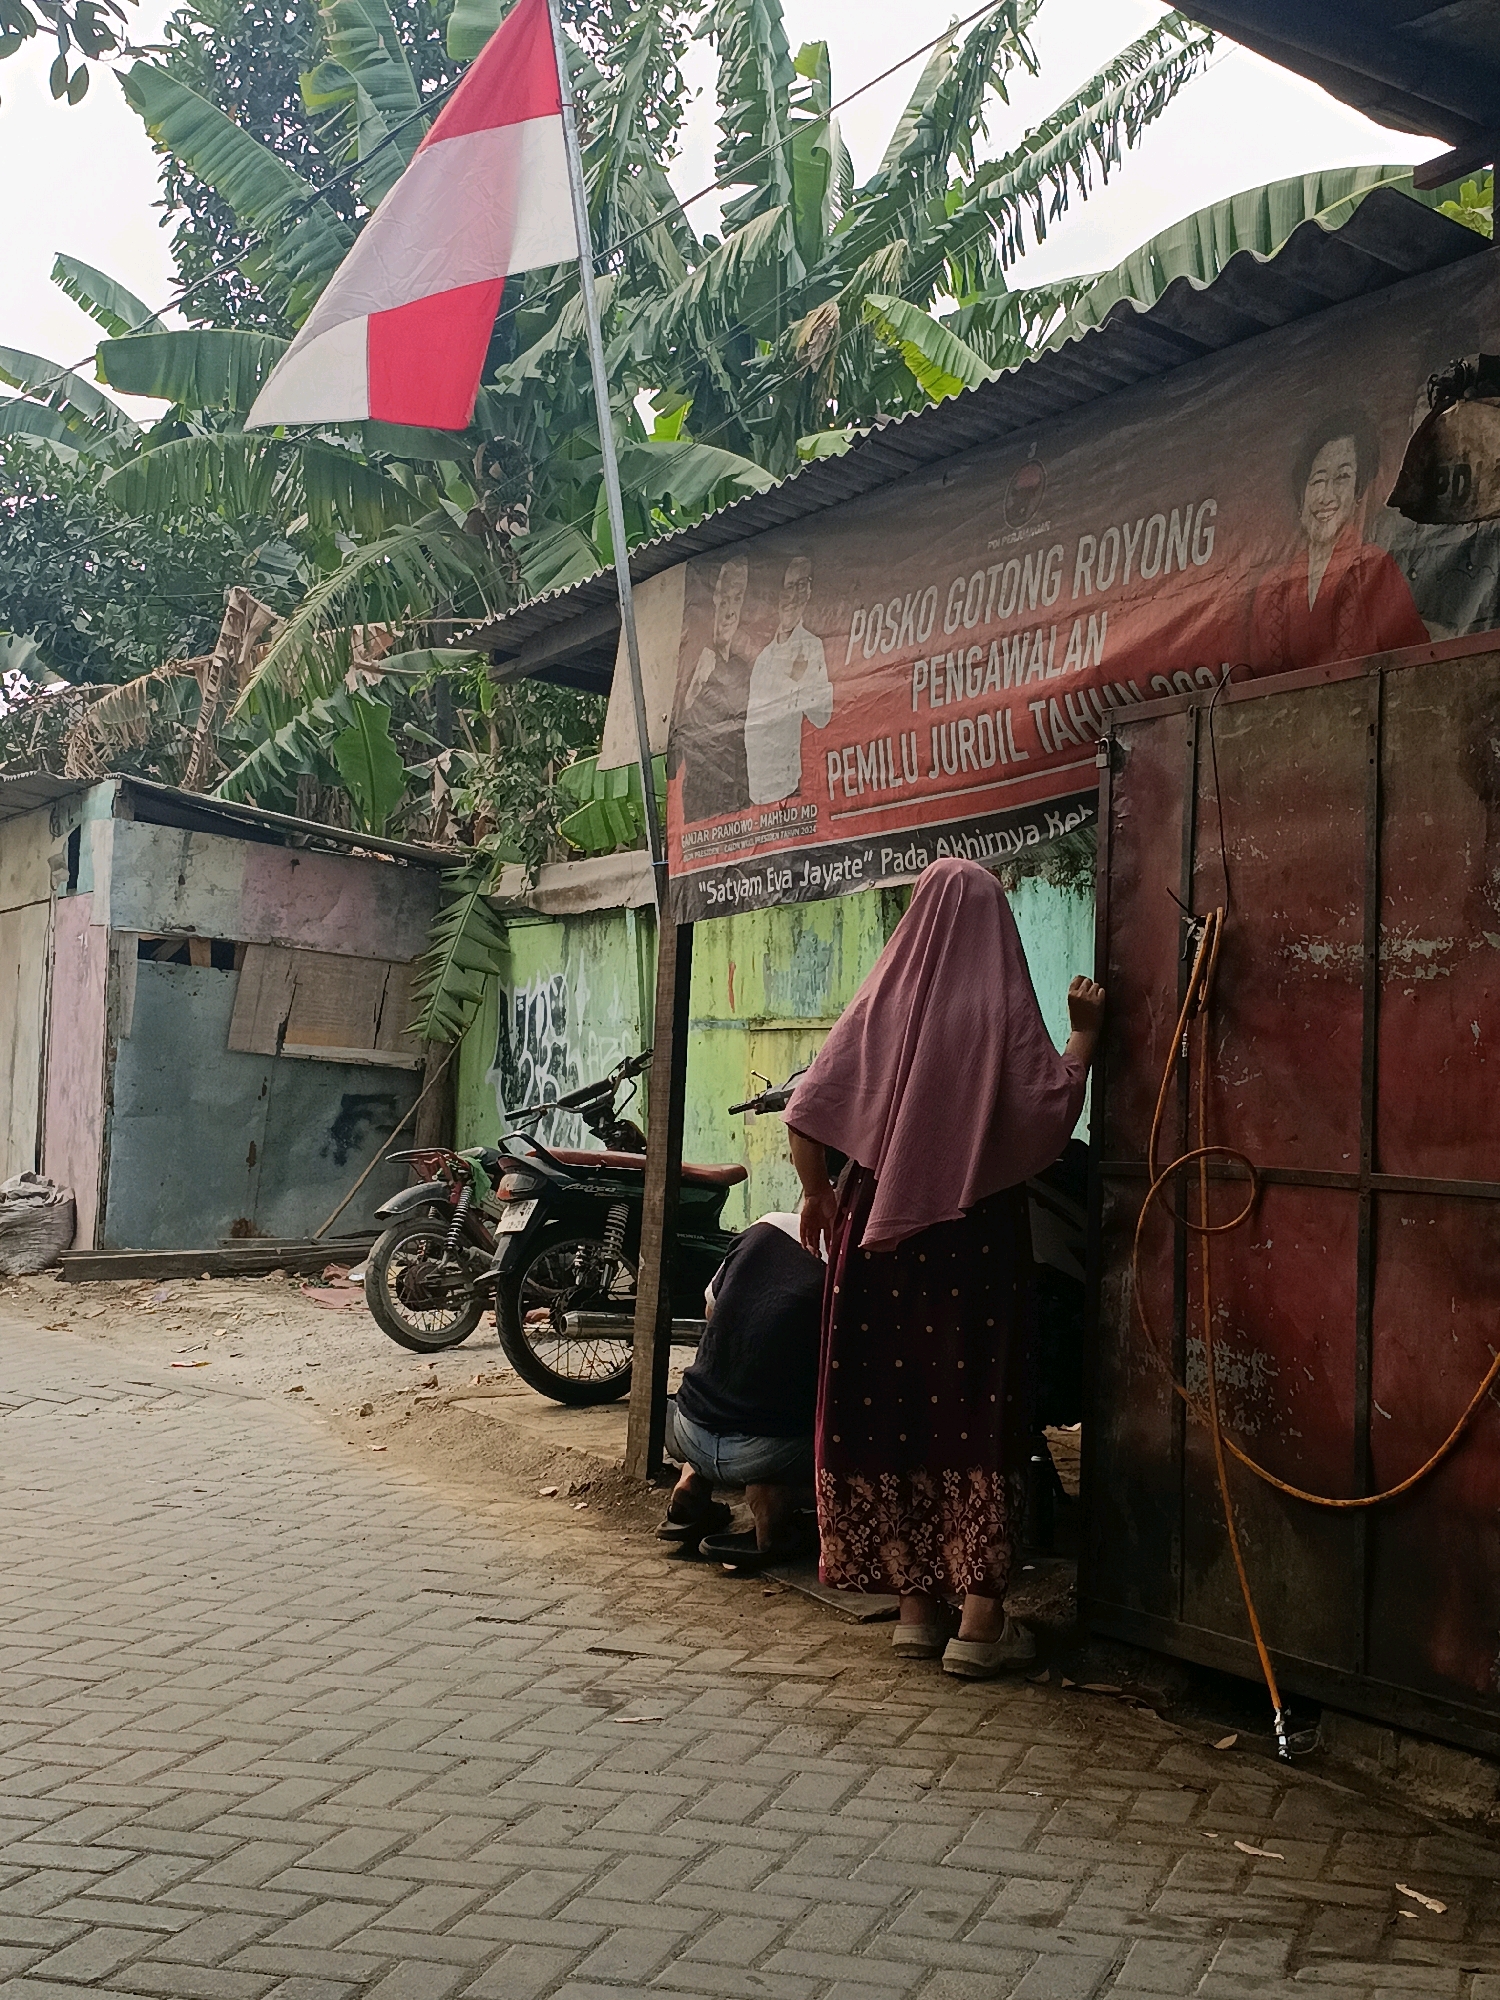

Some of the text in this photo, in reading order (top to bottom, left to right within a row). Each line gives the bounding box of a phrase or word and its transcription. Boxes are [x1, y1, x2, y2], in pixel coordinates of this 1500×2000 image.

[844, 498, 1218, 666] POSKO GOTONG ROYONG
[911, 610, 1109, 713] PENGAWALAN
[826, 730, 919, 801] PEMILU
[927, 707, 1030, 781] JURDIL
[698, 874, 763, 906] "Satyam
[766, 866, 793, 893] Eva
[799, 850, 874, 892] Jayate"
[880, 842, 929, 875] Pada
[936, 823, 1040, 860] Akhirnya
[711, 817, 753, 841] PRANOWO
[759, 808, 799, 829] MAHFUD
[800, 803, 818, 820] MD
